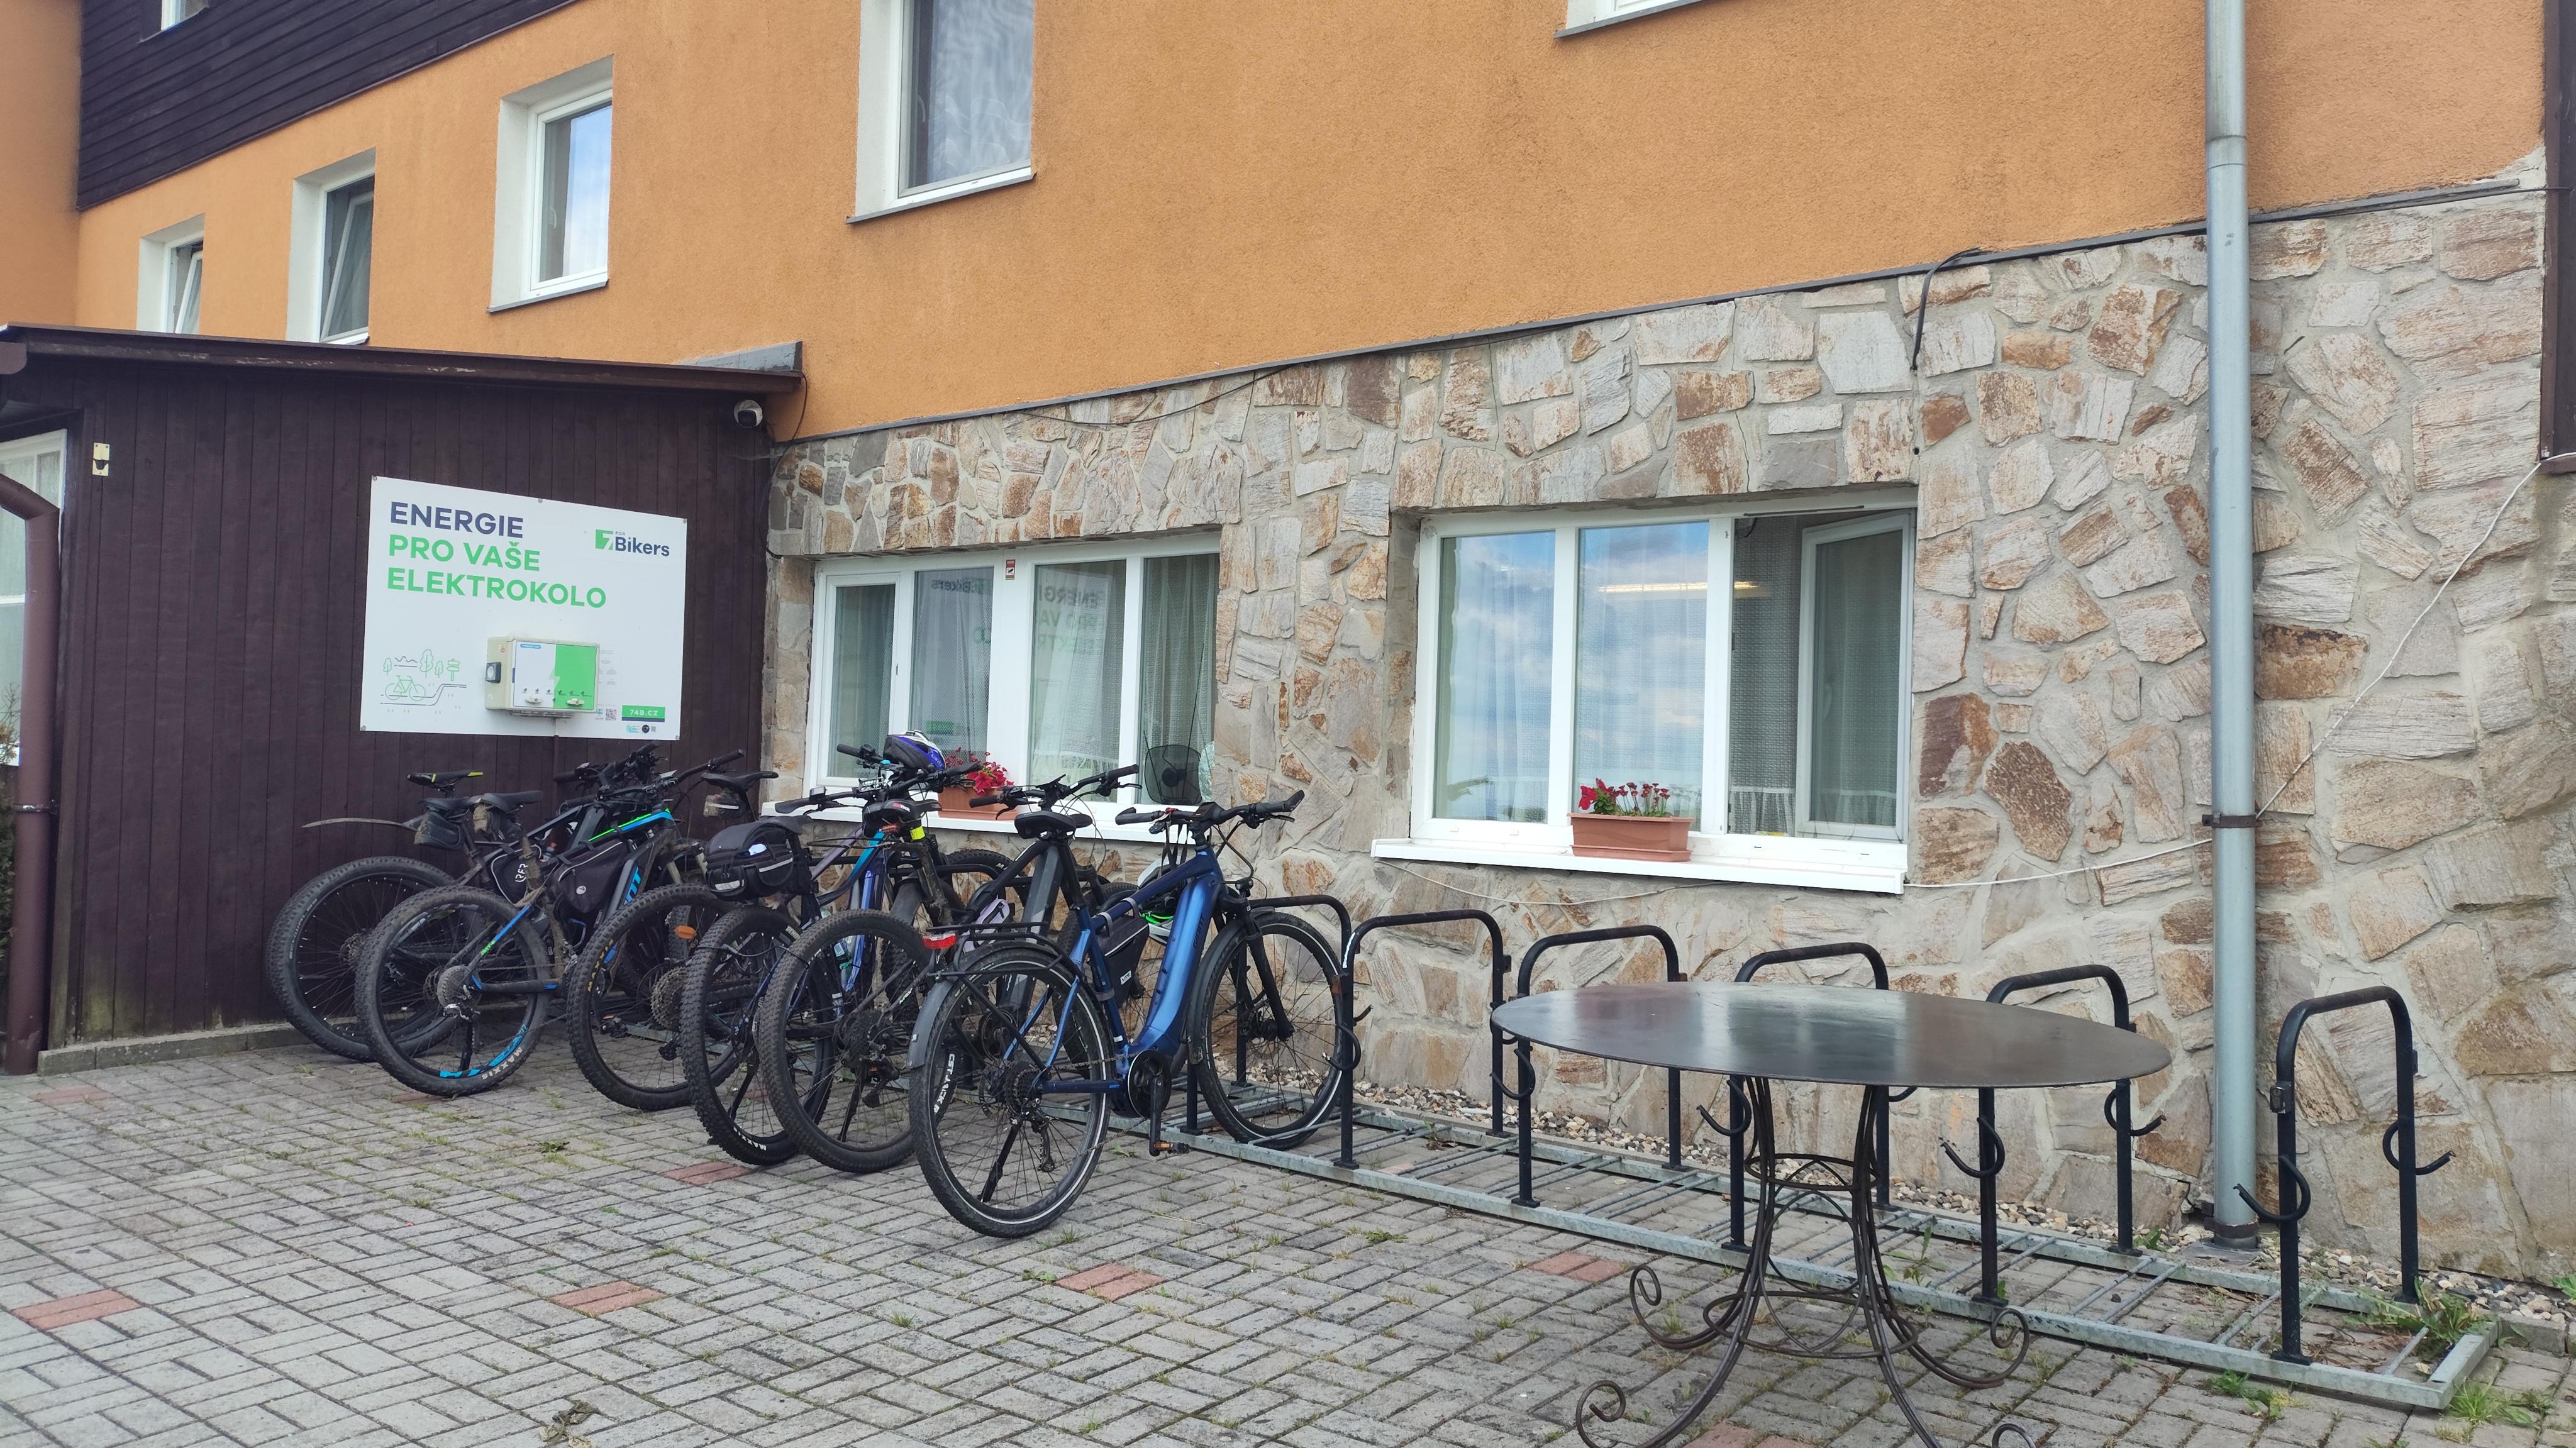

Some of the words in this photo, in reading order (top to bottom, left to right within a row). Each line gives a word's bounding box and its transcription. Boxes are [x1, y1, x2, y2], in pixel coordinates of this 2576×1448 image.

[391, 501, 524, 539] ENERGIE
[389, 534, 454, 562] PRO
[463, 541, 540, 572] VAŠE
[615, 536, 670, 557] Bikers
[387, 567, 606, 609] ELEKTROKOLO
[481, 1046, 523, 1080] MAXXIS
